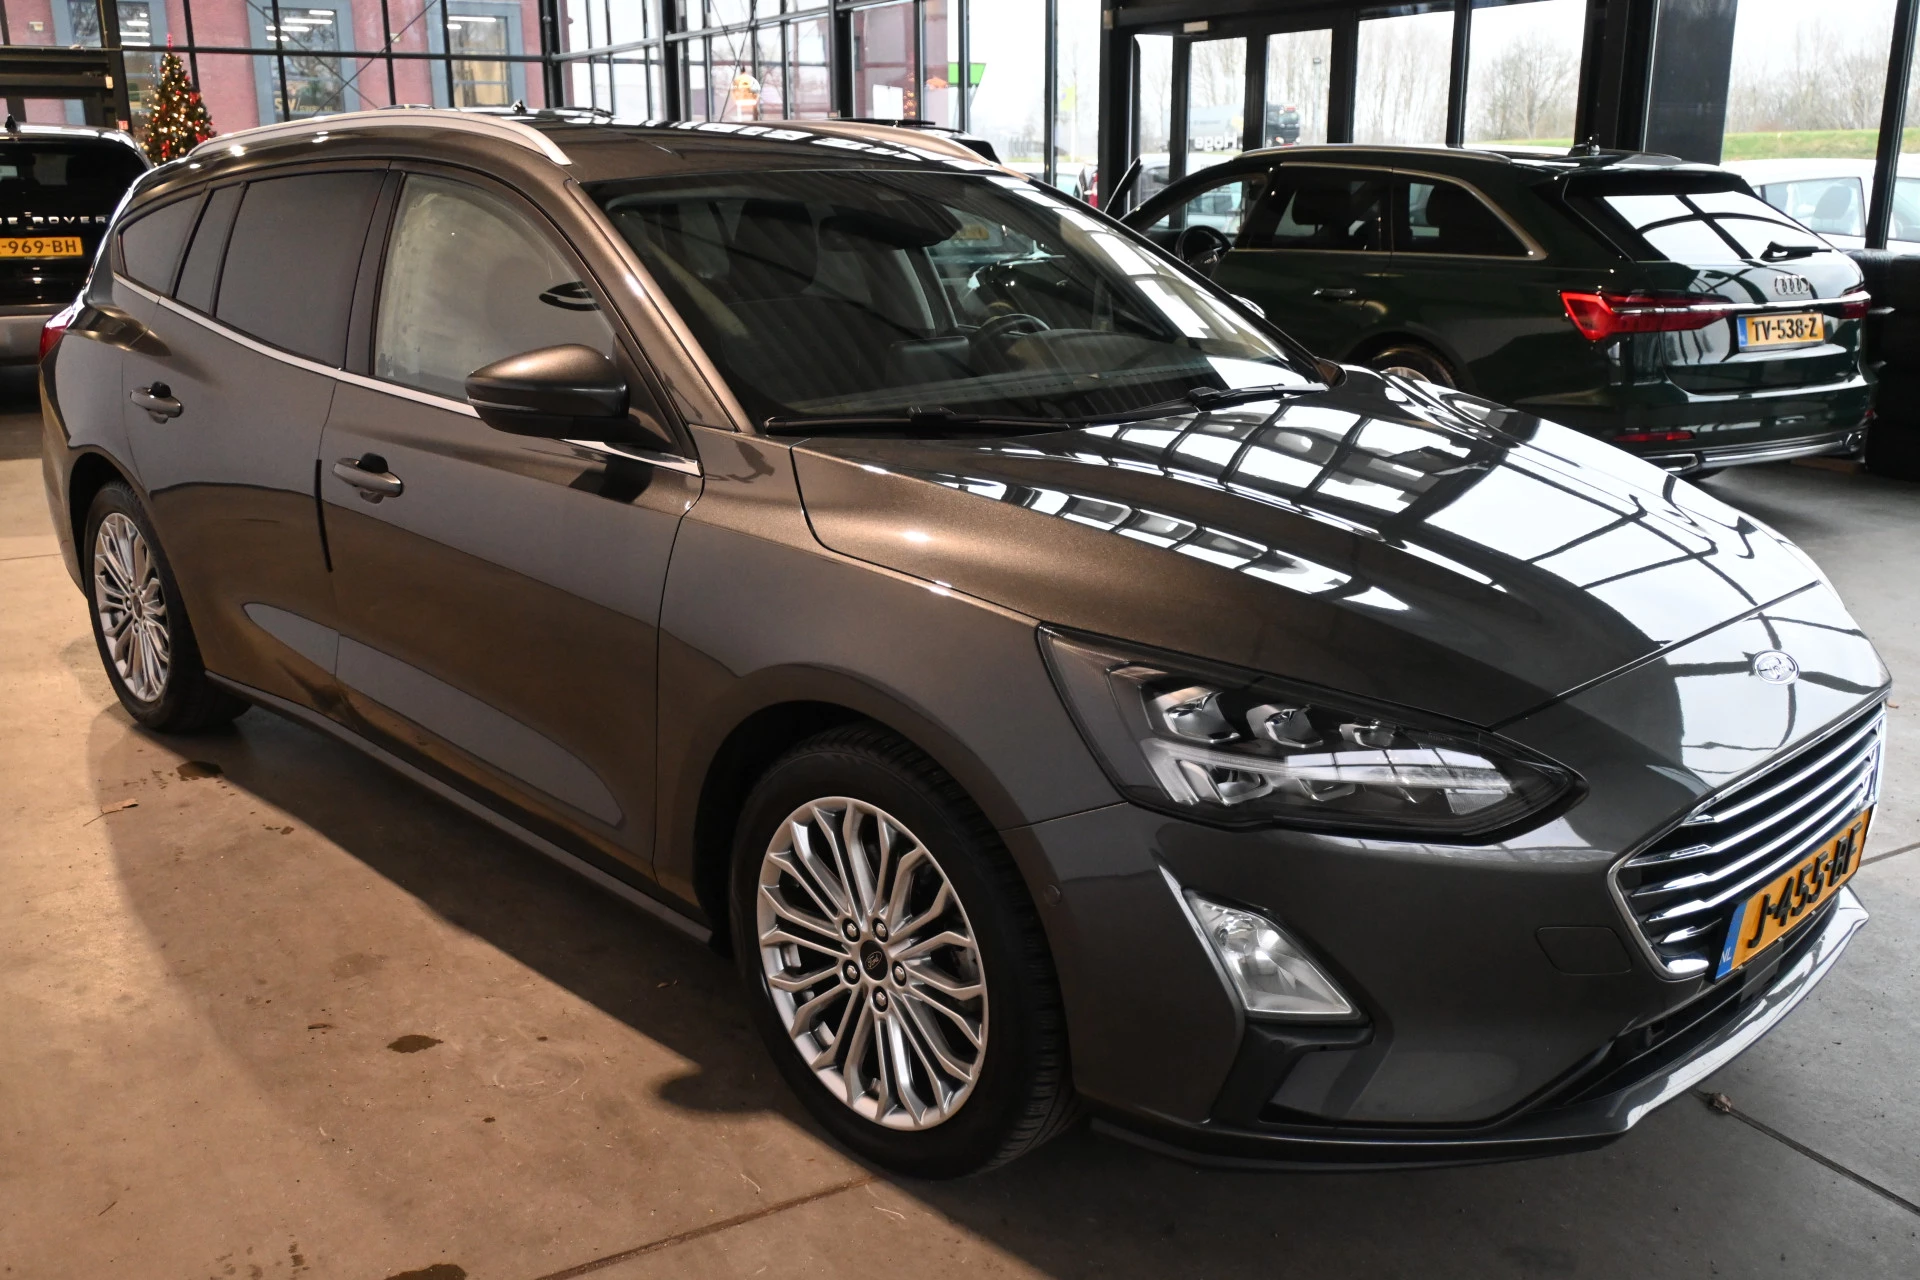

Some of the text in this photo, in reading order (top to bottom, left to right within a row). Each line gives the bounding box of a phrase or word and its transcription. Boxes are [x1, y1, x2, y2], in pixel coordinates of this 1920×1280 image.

[32, 216, 106, 224] ROVER
[0, 240, 77, 254] -969-BH
[1752, 317, 1818, 342] TV-538-Z
[1747, 821, 1863, 949] J-455-BF
[1719, 946, 1732, 967] NL
